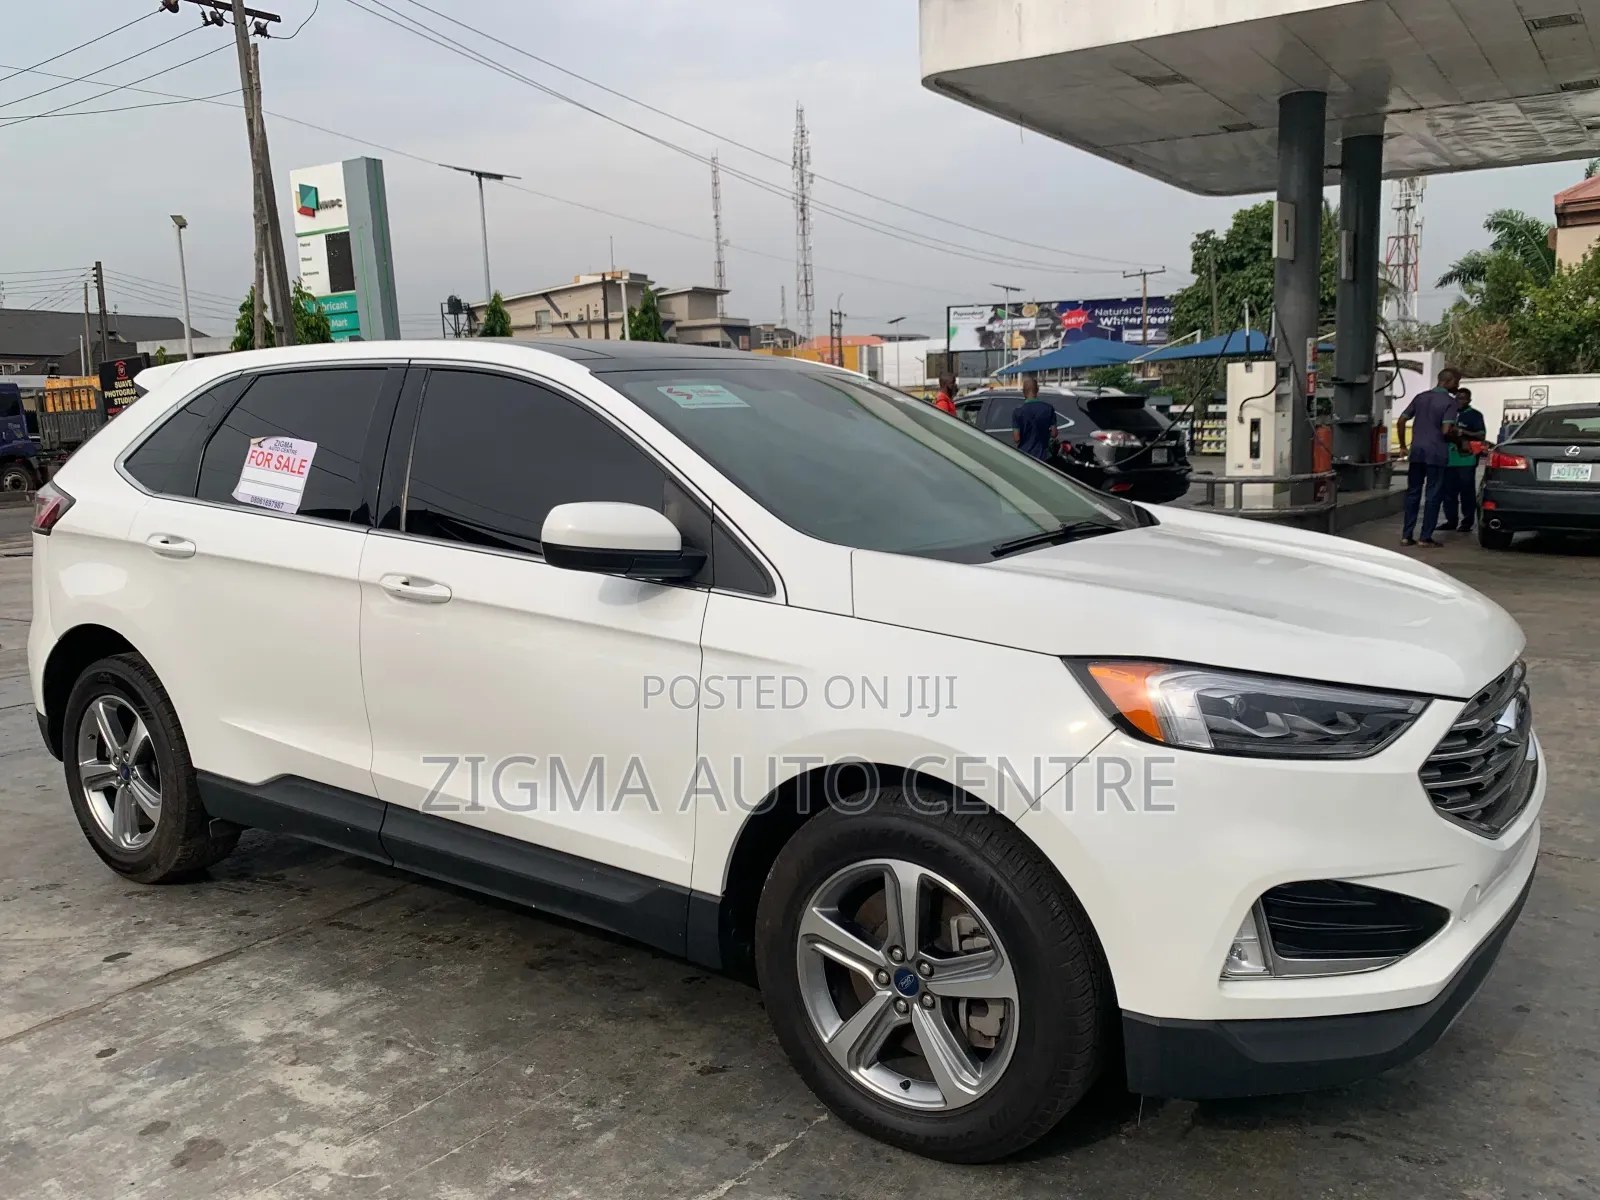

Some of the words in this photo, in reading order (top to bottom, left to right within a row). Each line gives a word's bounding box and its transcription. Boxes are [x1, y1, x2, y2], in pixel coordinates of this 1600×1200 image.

[313, 300, 349, 312] Lbricant
[1095, 307, 1132, 316] Natural
[331, 317, 348, 327] Mart
[1064, 316, 1086, 325] NEW
[114, 379, 133, 389] SUAVE
[274, 439, 293, 449] ZIGMA
[248, 450, 274, 468] FOR
[274, 454, 308, 475] SALE
